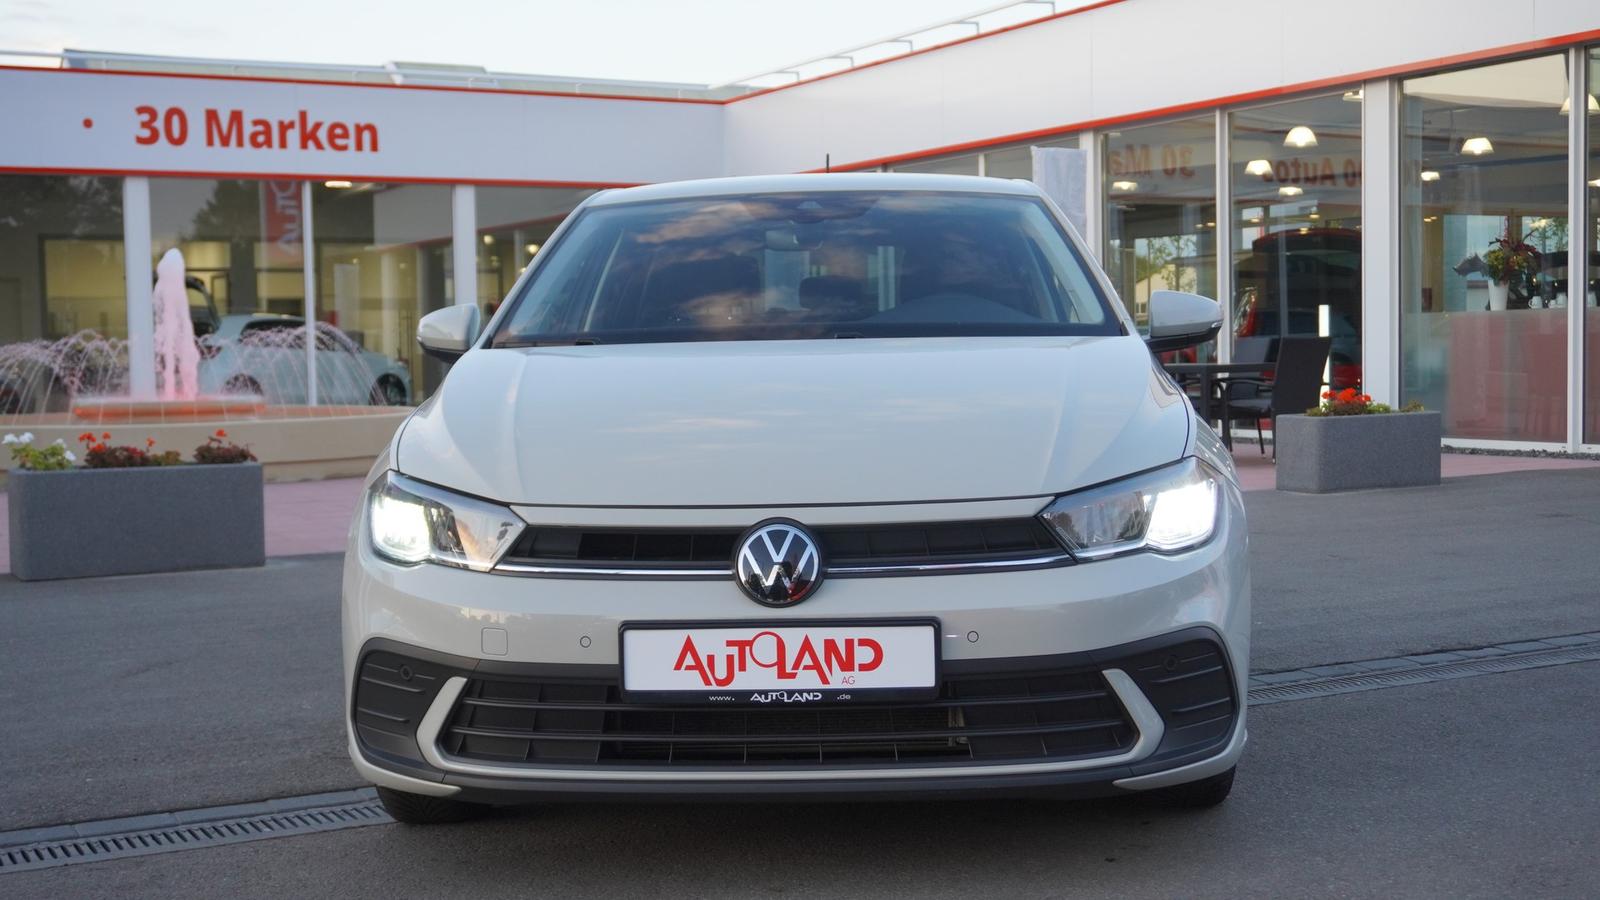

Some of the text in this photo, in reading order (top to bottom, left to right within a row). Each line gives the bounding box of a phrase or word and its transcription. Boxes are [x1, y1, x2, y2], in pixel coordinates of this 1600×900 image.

[134, 105, 379, 152] 30 Marken
[740, 525, 817, 602] VW
[673, 631, 884, 686] AUTOLAND
[841, 675, 856, 685] AG
[750, 690, 822, 703] AUTOLAND
